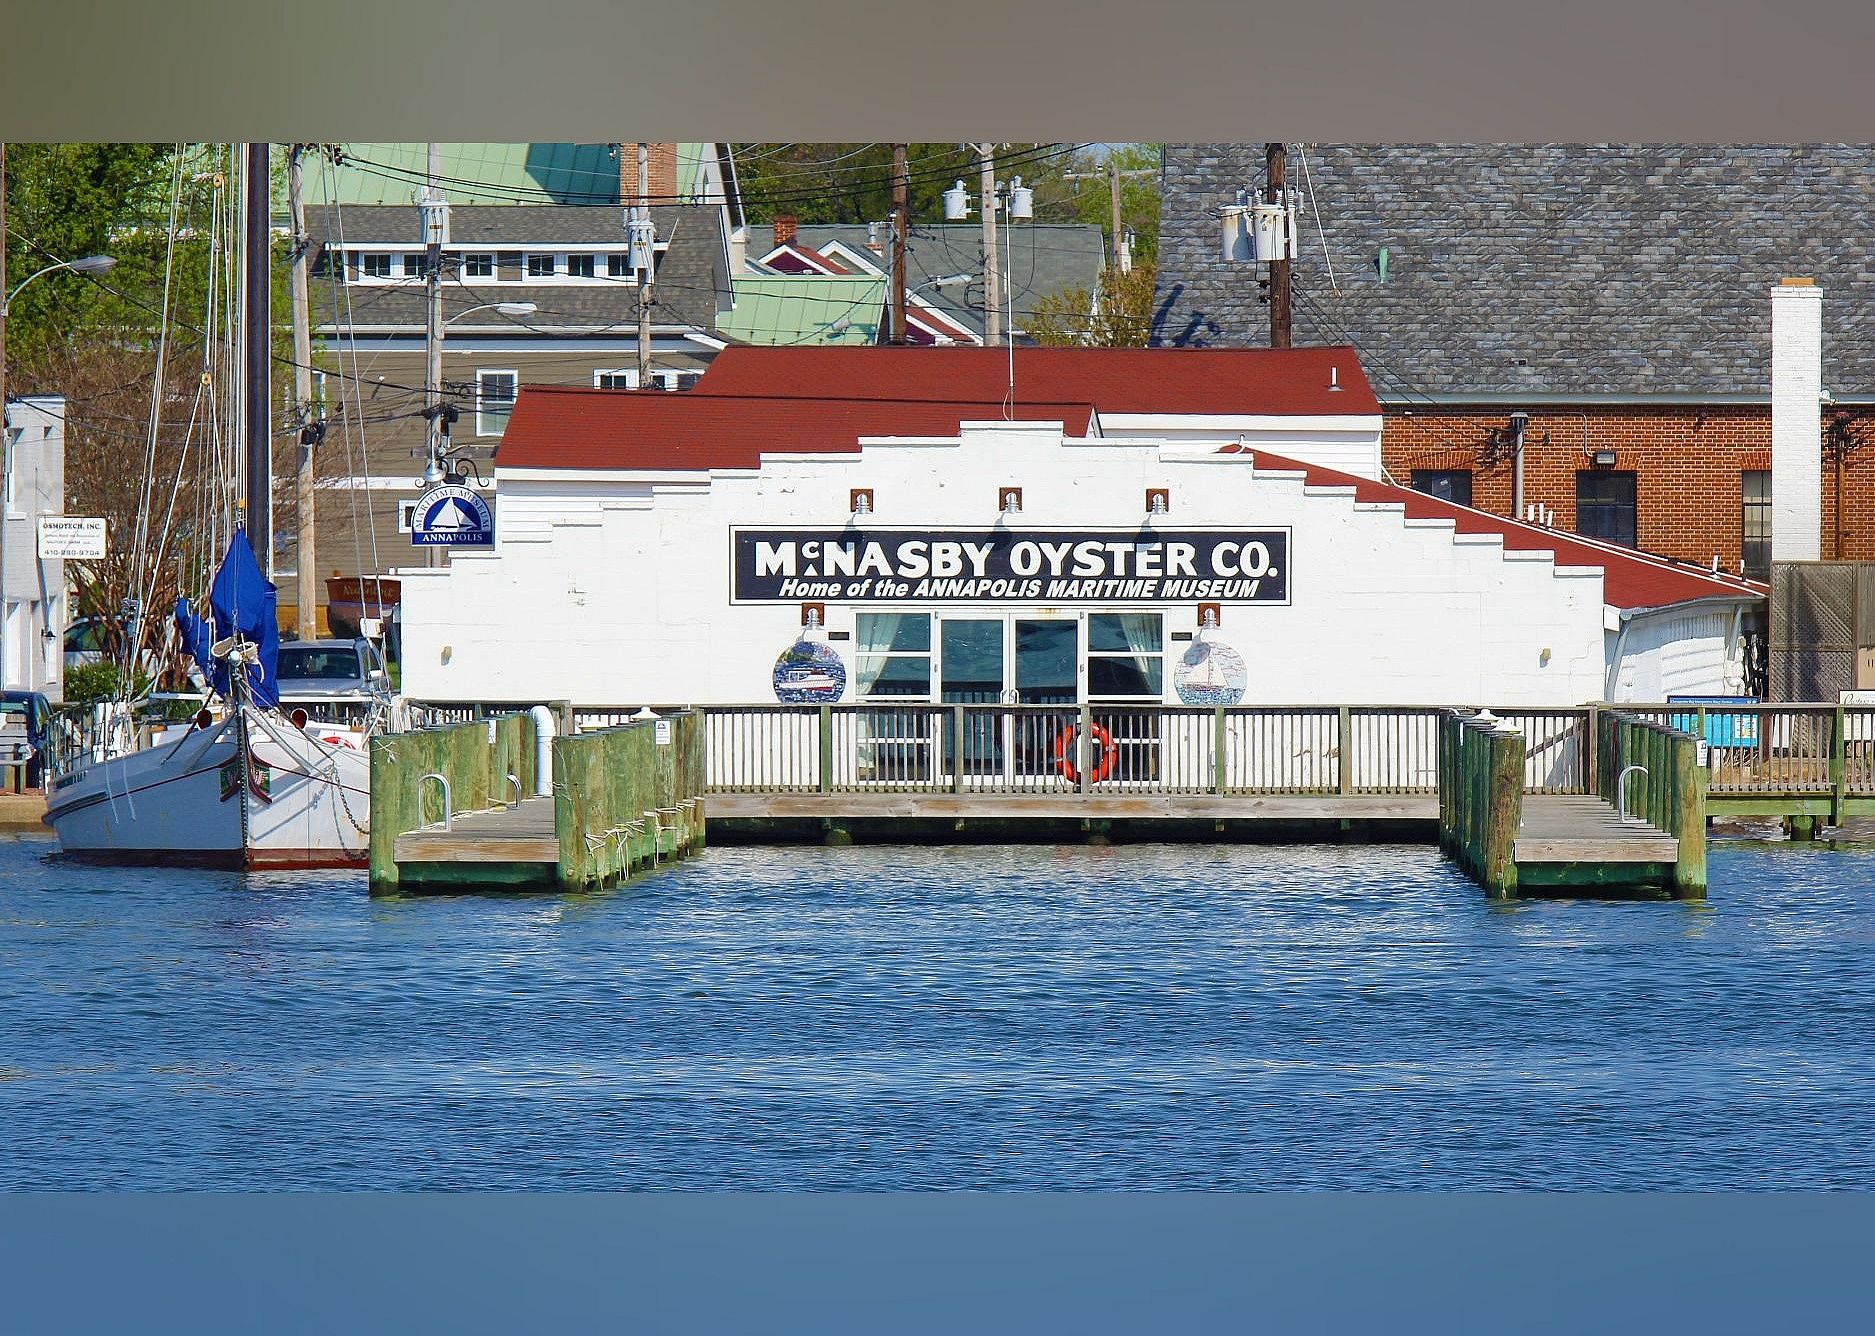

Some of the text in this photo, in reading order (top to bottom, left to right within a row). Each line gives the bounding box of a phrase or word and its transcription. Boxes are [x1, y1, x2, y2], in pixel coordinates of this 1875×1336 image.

[415, 488, 489, 528] MARITIME MUSEUM
[423, 533, 483, 542] ANNAPOLIS
[1009, 540, 1198, 578] OYSTER
[1211, 540, 1279, 578] CO.
[778, 578, 1260, 598] Home of the ANNAPOLIS MARITIME MUSEUM
